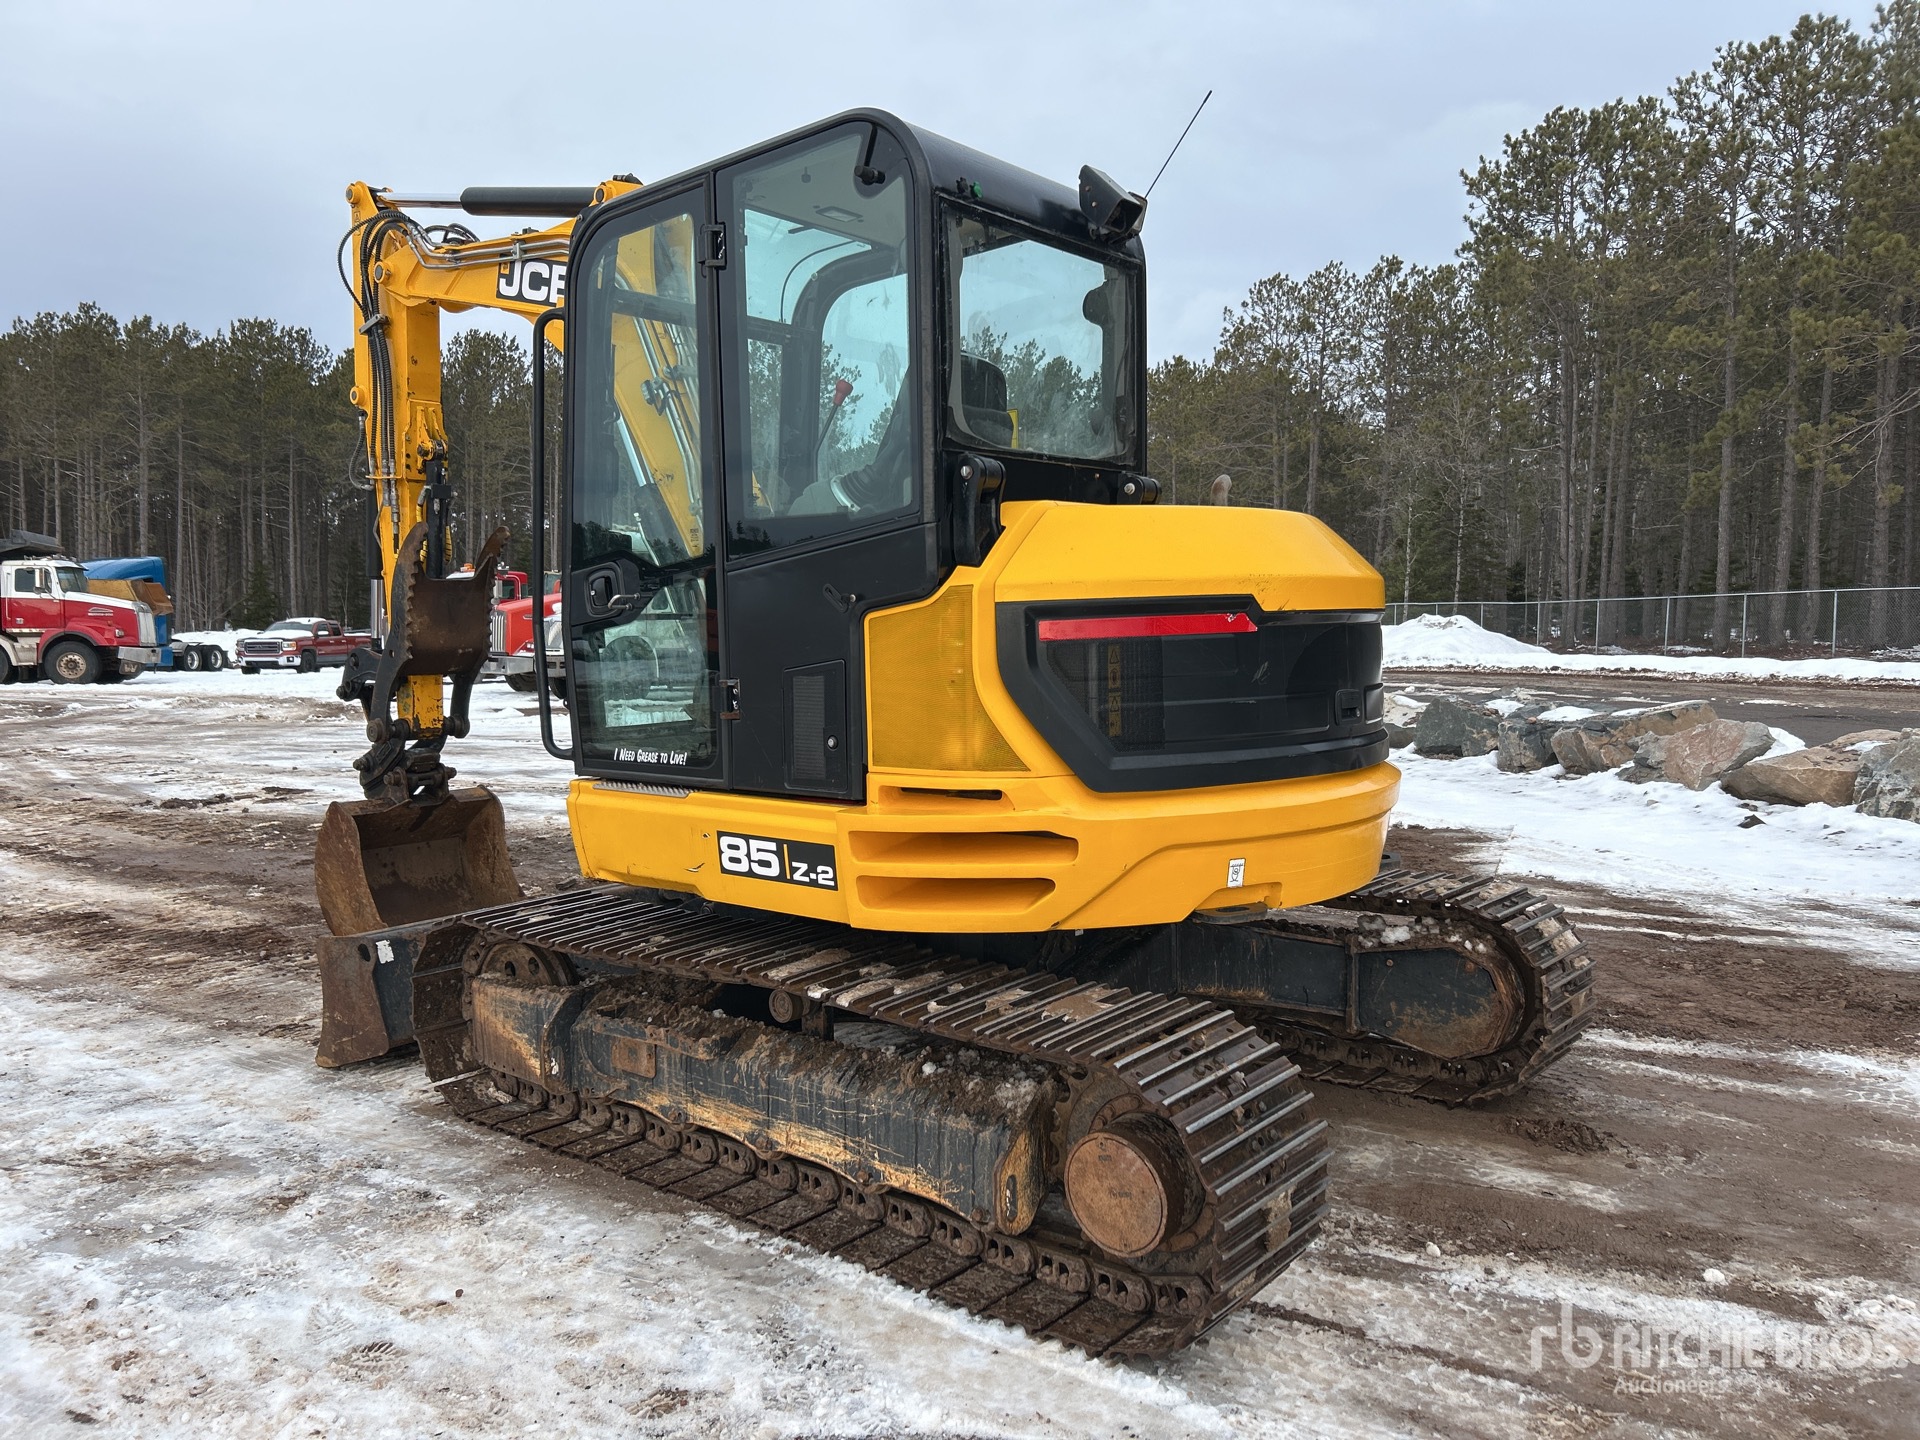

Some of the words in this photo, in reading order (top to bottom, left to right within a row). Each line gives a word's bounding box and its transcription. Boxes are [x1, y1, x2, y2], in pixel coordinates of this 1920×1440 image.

[613, 747, 618, 761] I
[719, 836, 780, 877] 85
[791, 861, 835, 886] Z-2
